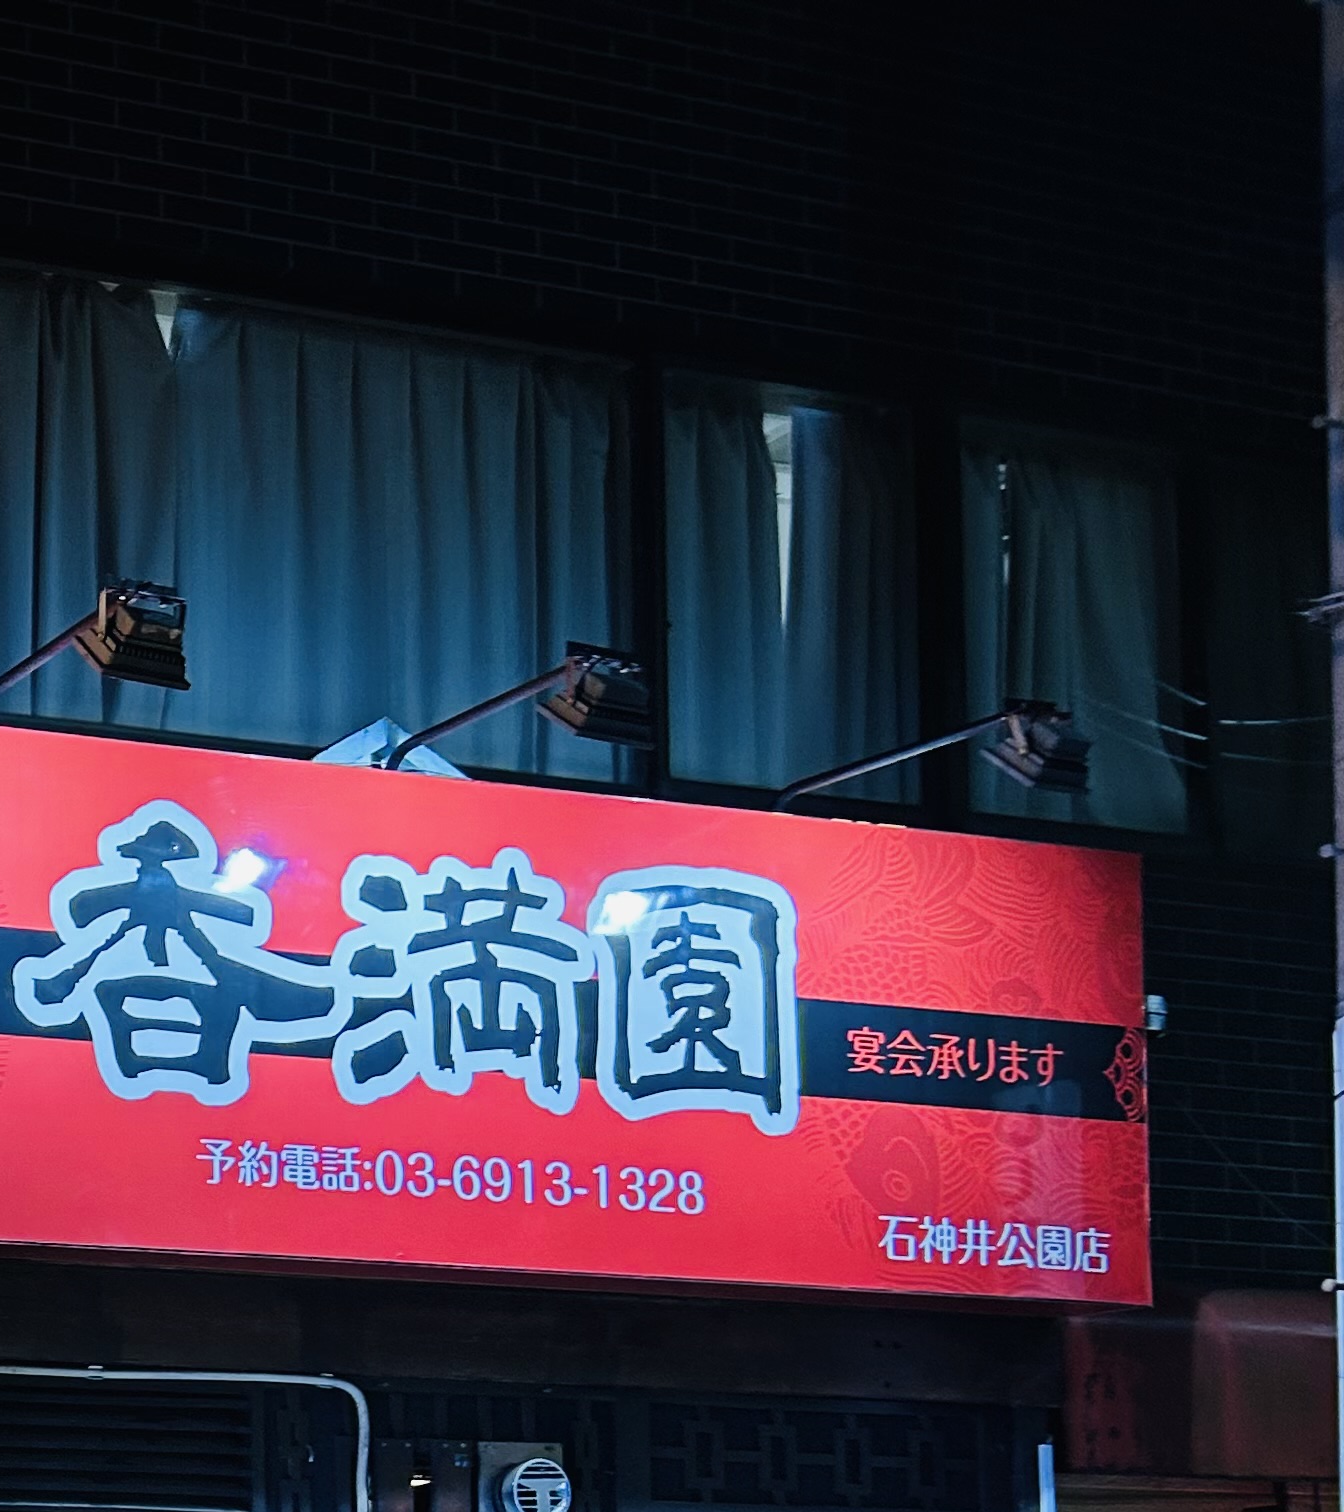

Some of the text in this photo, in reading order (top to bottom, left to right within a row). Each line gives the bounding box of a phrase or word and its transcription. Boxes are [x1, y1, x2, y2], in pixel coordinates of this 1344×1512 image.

[38, 815, 784, 1118] 香満園
[845, 1025, 1065, 1091] 宴会承ります
[196, 1136, 705, 1219] 予約電話:03-6913-1328
[877, 1214, 1111, 1277] 石神井公園店
